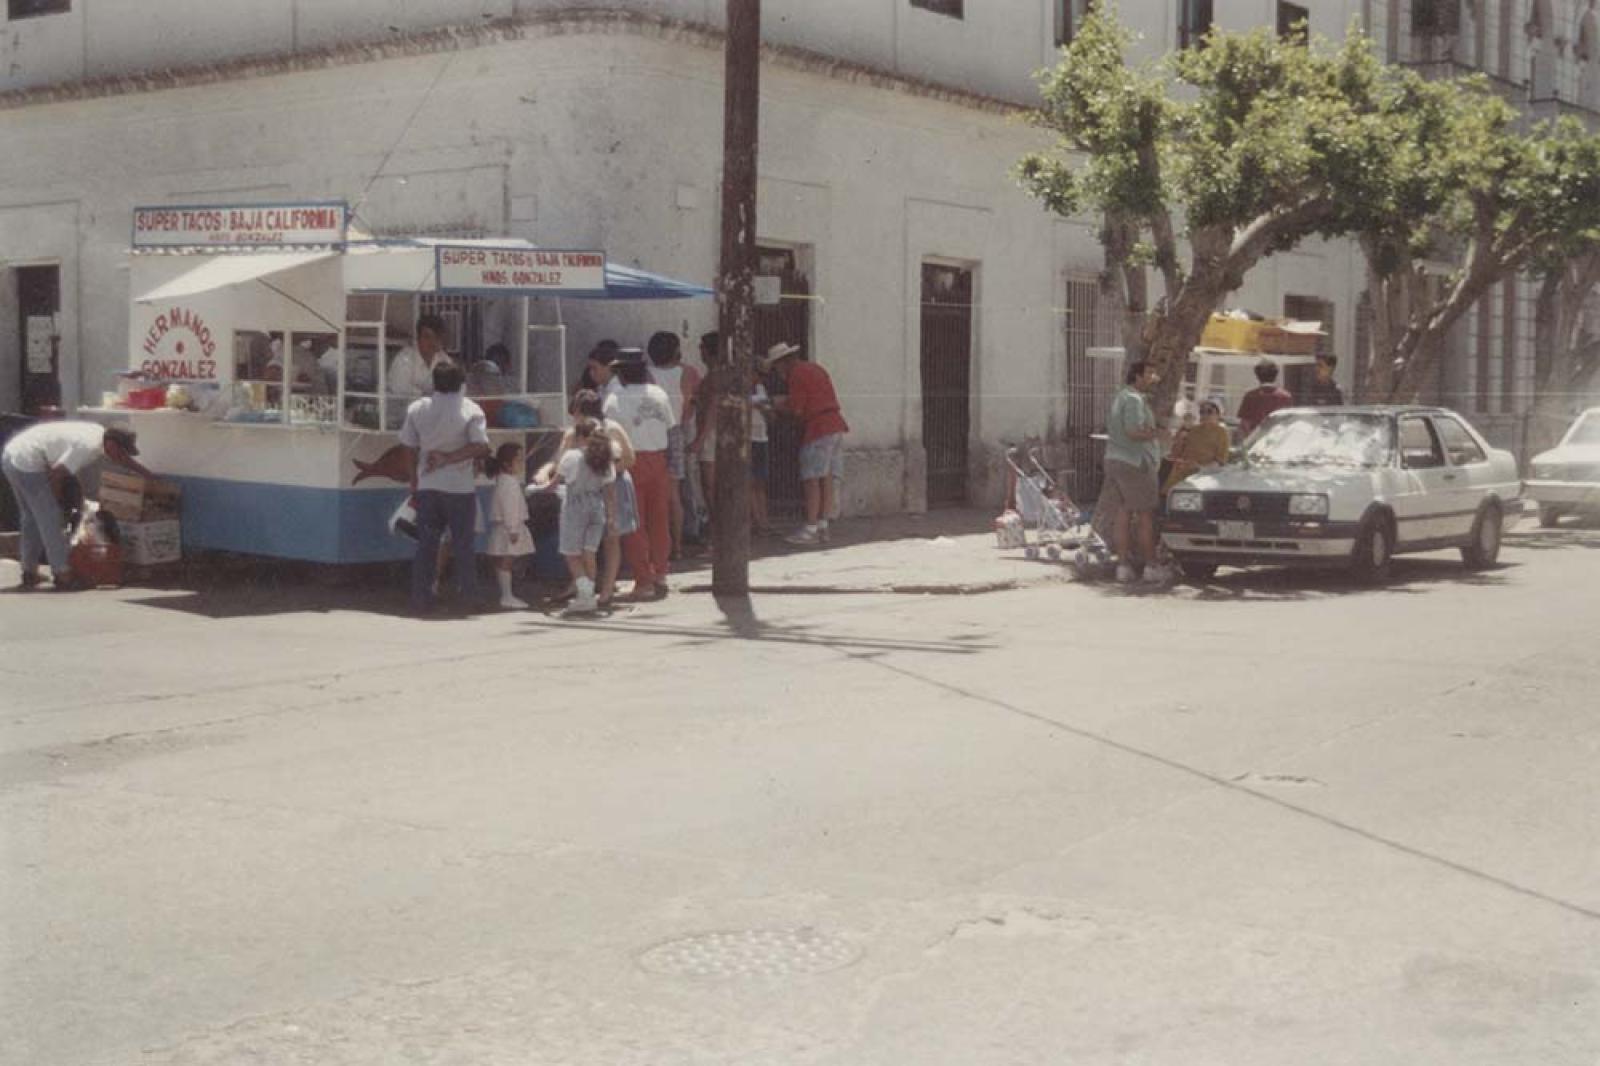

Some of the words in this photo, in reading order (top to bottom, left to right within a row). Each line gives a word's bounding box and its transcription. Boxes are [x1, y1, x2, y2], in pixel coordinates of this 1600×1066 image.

[138, 212, 179, 231] SUPER
[230, 210, 263, 230] BAJA
[266, 207, 336, 230] CALIFORNIA
[442, 252, 485, 265] SUPER
[512, 271, 562, 286] GONZALEZ
[143, 306, 216, 357] HERMANOS
[143, 360, 216, 379] GONZALEZ
